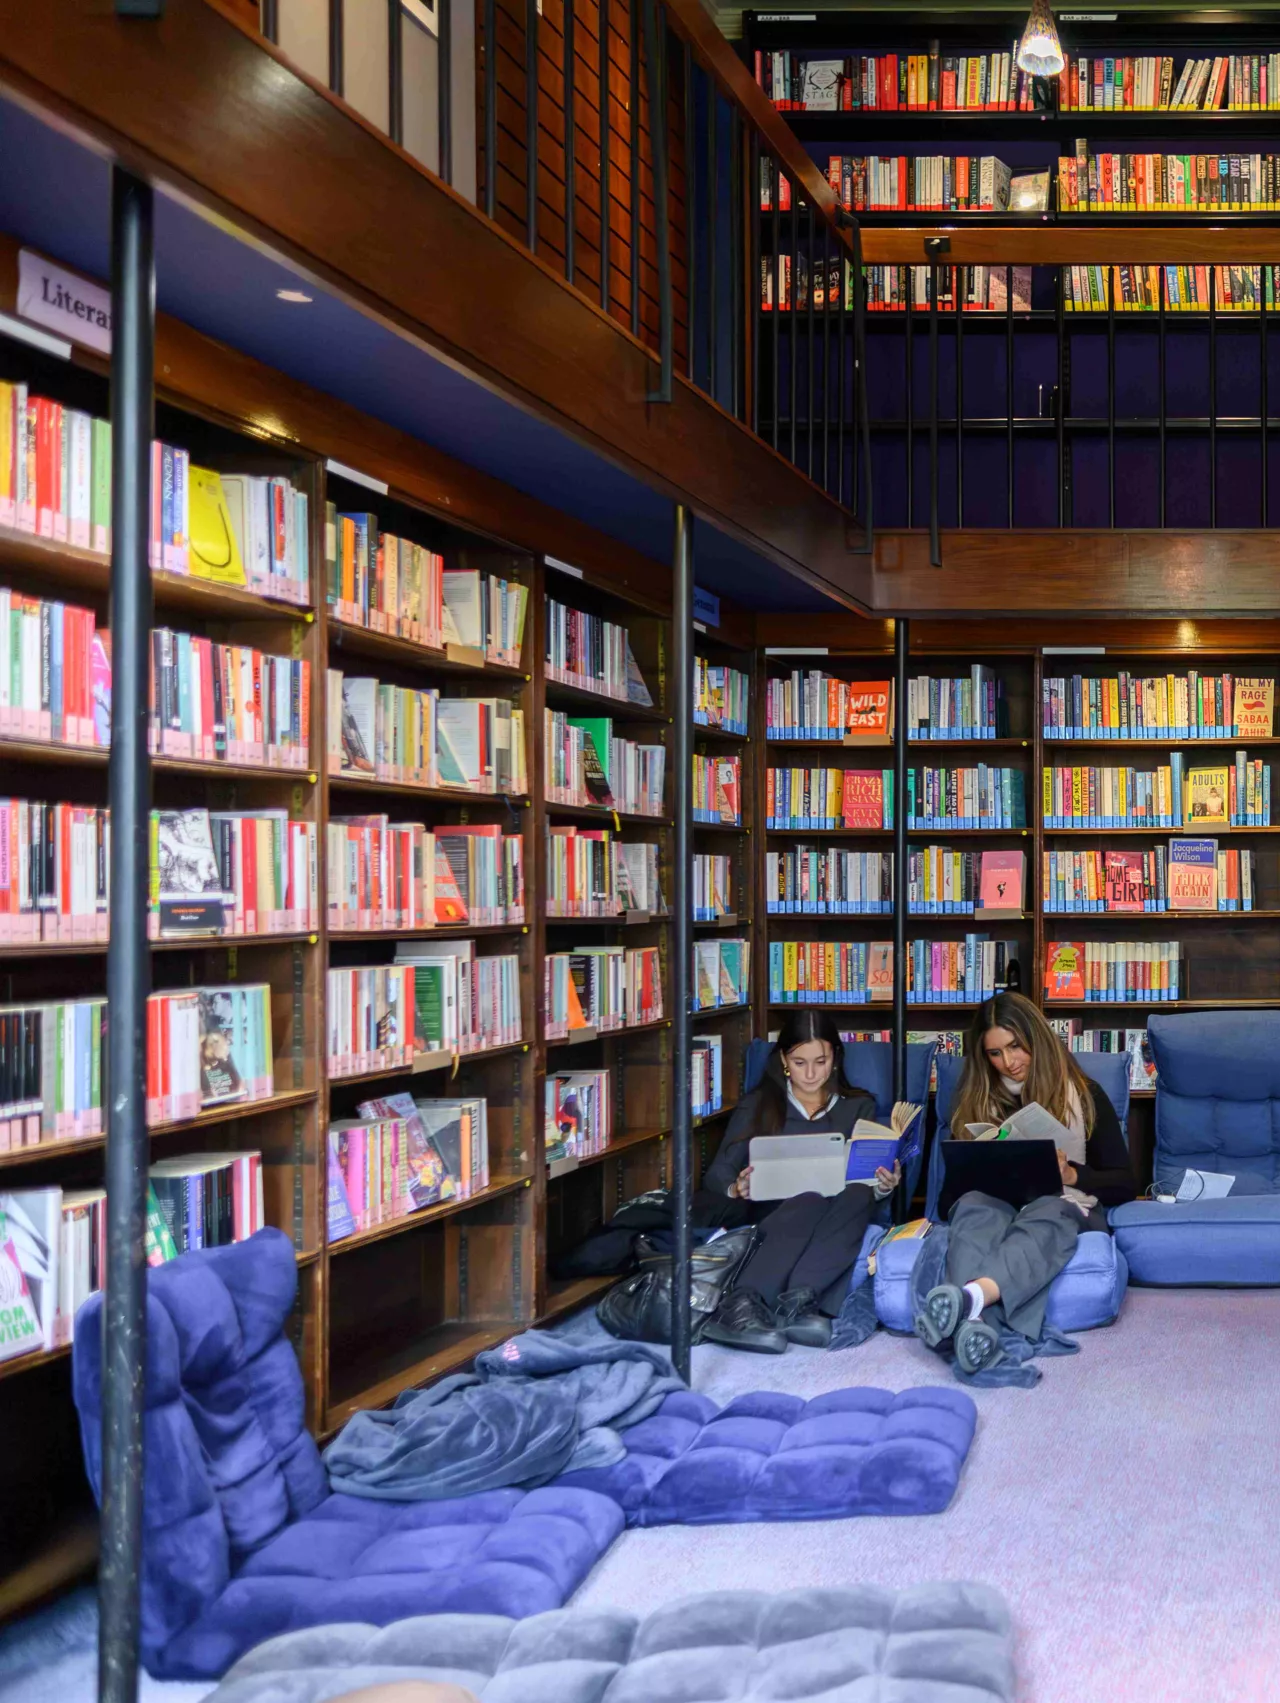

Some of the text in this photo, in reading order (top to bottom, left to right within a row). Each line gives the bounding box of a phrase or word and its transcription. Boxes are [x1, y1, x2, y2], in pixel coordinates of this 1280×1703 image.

[1230, 159, 1240, 177] FEAR
[1240, 158, 1250, 180] LIGHT
[1236, 678, 1273, 688] ALL MY
[851, 693, 887, 709] WILD
[1241, 690, 1267, 700] RAGE
[850, 712, 886, 727] EAST
[1236, 714, 1269, 724] SABAA
[1237, 727, 1267, 737] TAHIR
[846, 775, 882, 788] CRAZY
[1192, 773, 1225, 786] ADULTS
[846, 786, 882, 797] RICH
[846, 795, 882, 804] ASIANS
[845, 807, 881, 819] KEVIN
[845, 818, 882, 829] KWAN
[1172, 843, 1214, 855] Jacqueline
[1173, 852, 1201, 862] Wilson
[1174, 873, 1211, 886] THINK
[1112, 882, 1144, 902] GIRL
[1174, 885, 1210, 898] AGAIN
